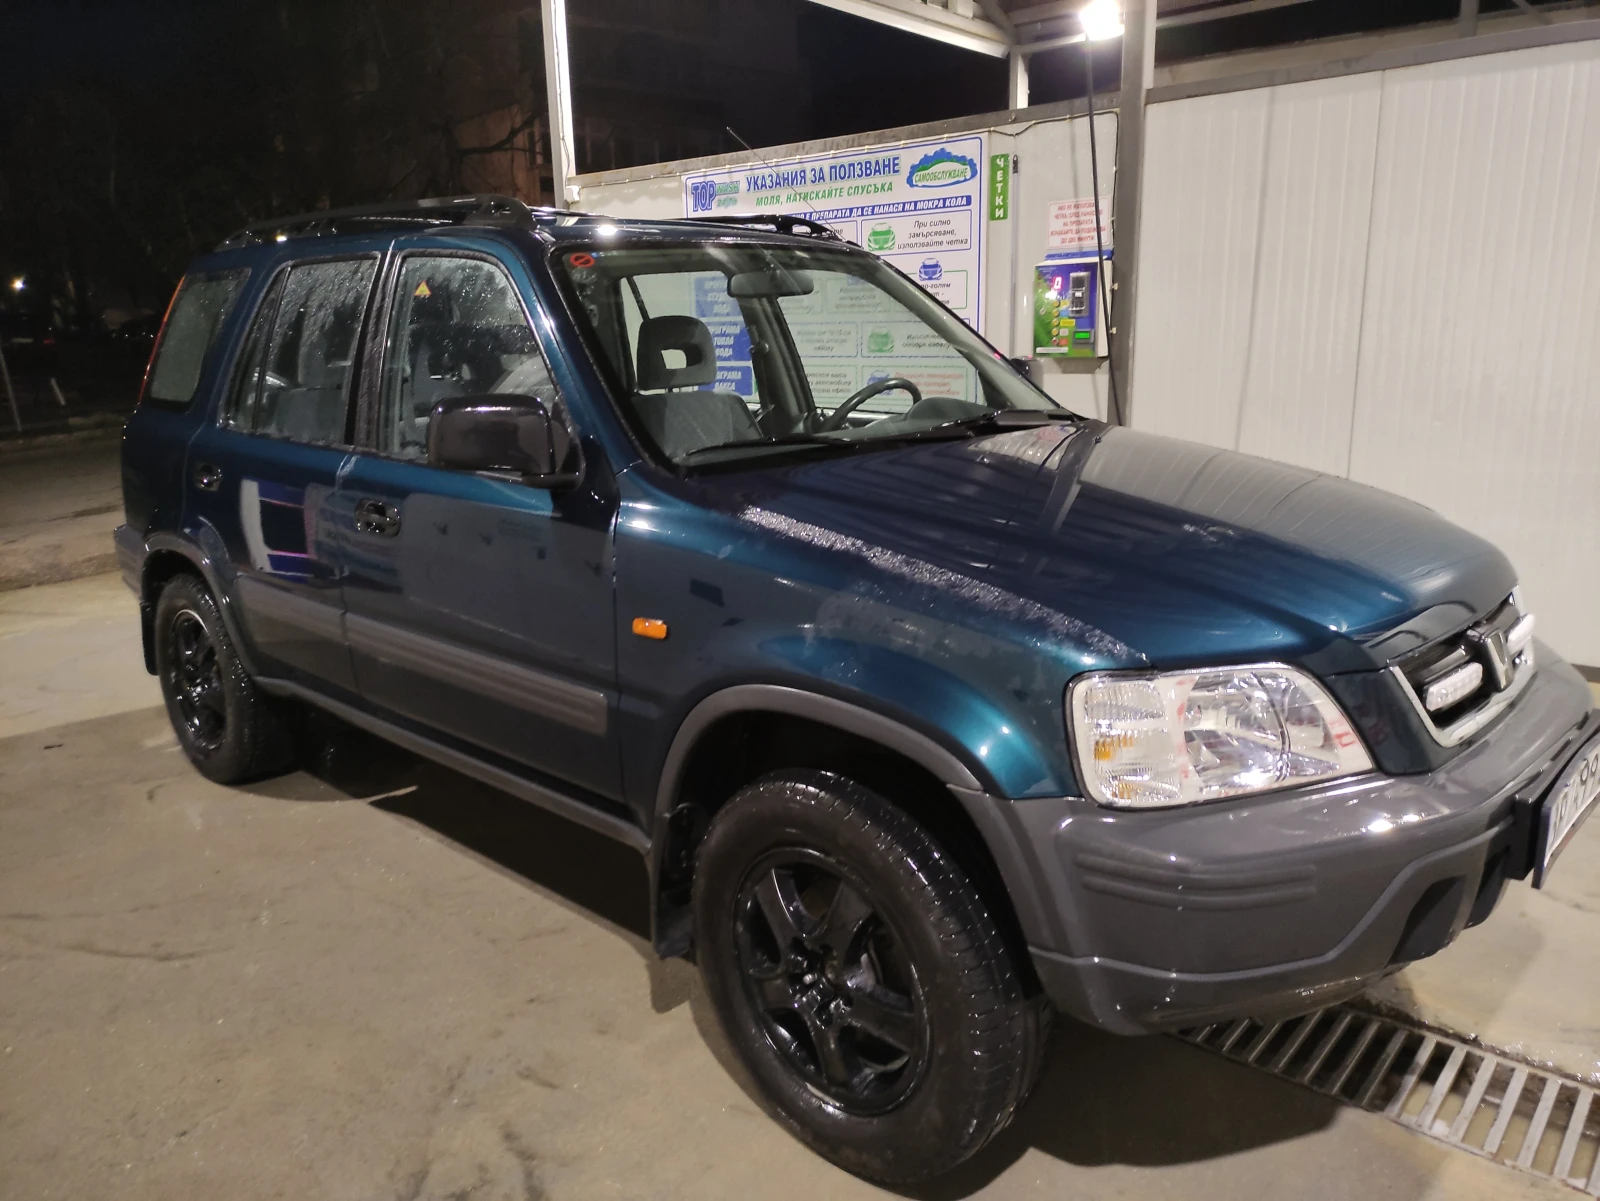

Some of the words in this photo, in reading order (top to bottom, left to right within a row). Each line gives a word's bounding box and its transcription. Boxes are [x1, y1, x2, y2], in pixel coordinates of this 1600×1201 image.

[746, 168, 806, 193] УКАЗАНИЯ
[810, 166, 825, 184] ЗА
[829, 156, 900, 182] ПОЛЗВАНЕ
[914, 167, 969, 184] САМООБСЛУЖВАНЕ
[691, 180, 716, 212] TOP
[716, 181, 740, 195] WASH
[755, 194, 783, 207] МОЛЯ,
[786, 186, 844, 203] НАТИСКАЙТЕ
[847, 181, 893, 197] СПУСЪКА
[996, 157, 1004, 218] ЧЕТКИ
[811, 208, 850, 220] ПРЕПАРАТА
[851, 207, 862, 217] ДА
[864, 206, 873, 215] СЕ
[874, 204, 902, 215] НАНАСЯ
[904, 203, 914, 212] НА
[916, 200, 943, 210] МОКРА
[945, 197, 967, 207] КОЛА
[908, 229, 956, 239] замърсяване,
[914, 220, 928, 229] При
[929, 219, 951, 228] силно
[897, 239, 944, 249] използвайте
[945, 238, 968, 246] четка
[716, 370, 742, 380] ОГРАМА
